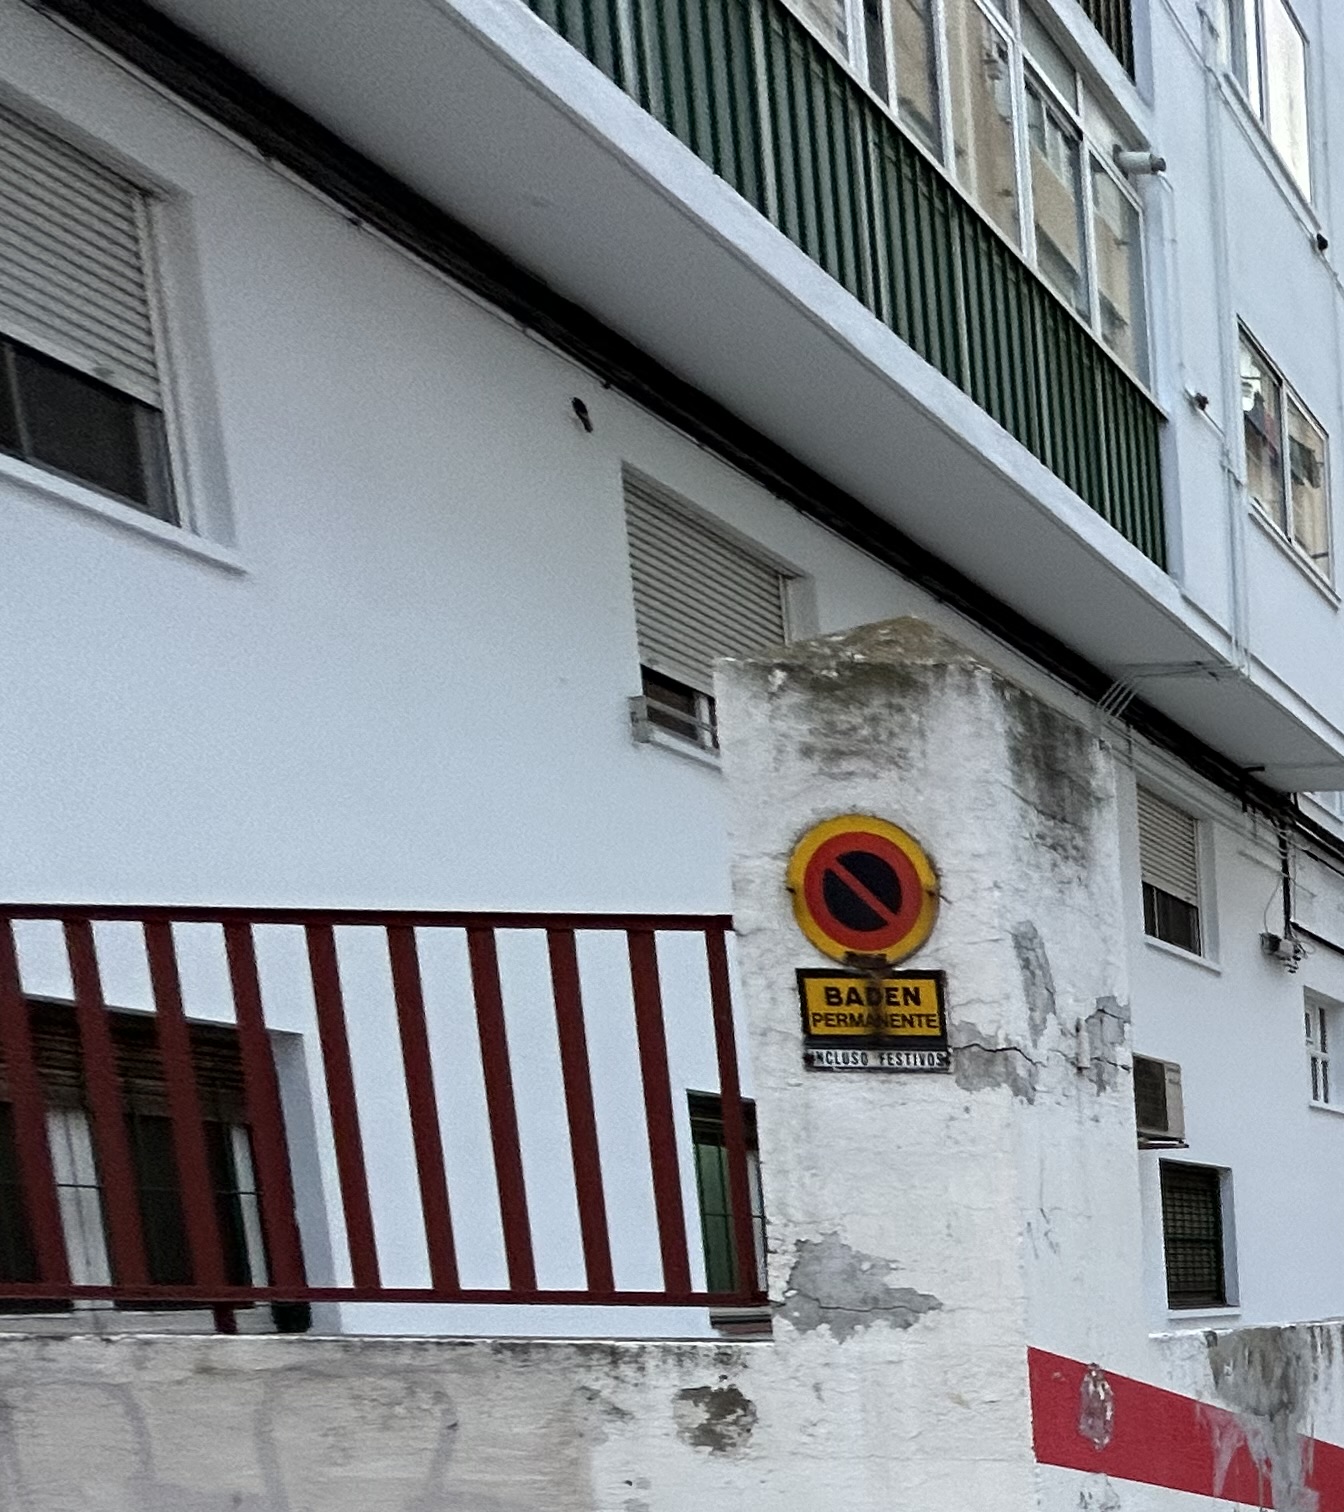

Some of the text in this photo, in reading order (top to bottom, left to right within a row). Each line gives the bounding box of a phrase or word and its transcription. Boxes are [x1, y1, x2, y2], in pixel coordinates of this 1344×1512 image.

[824, 986, 921, 1007] BADEN
[811, 1051, 945, 1067] NCLUSO FESTIVOS
